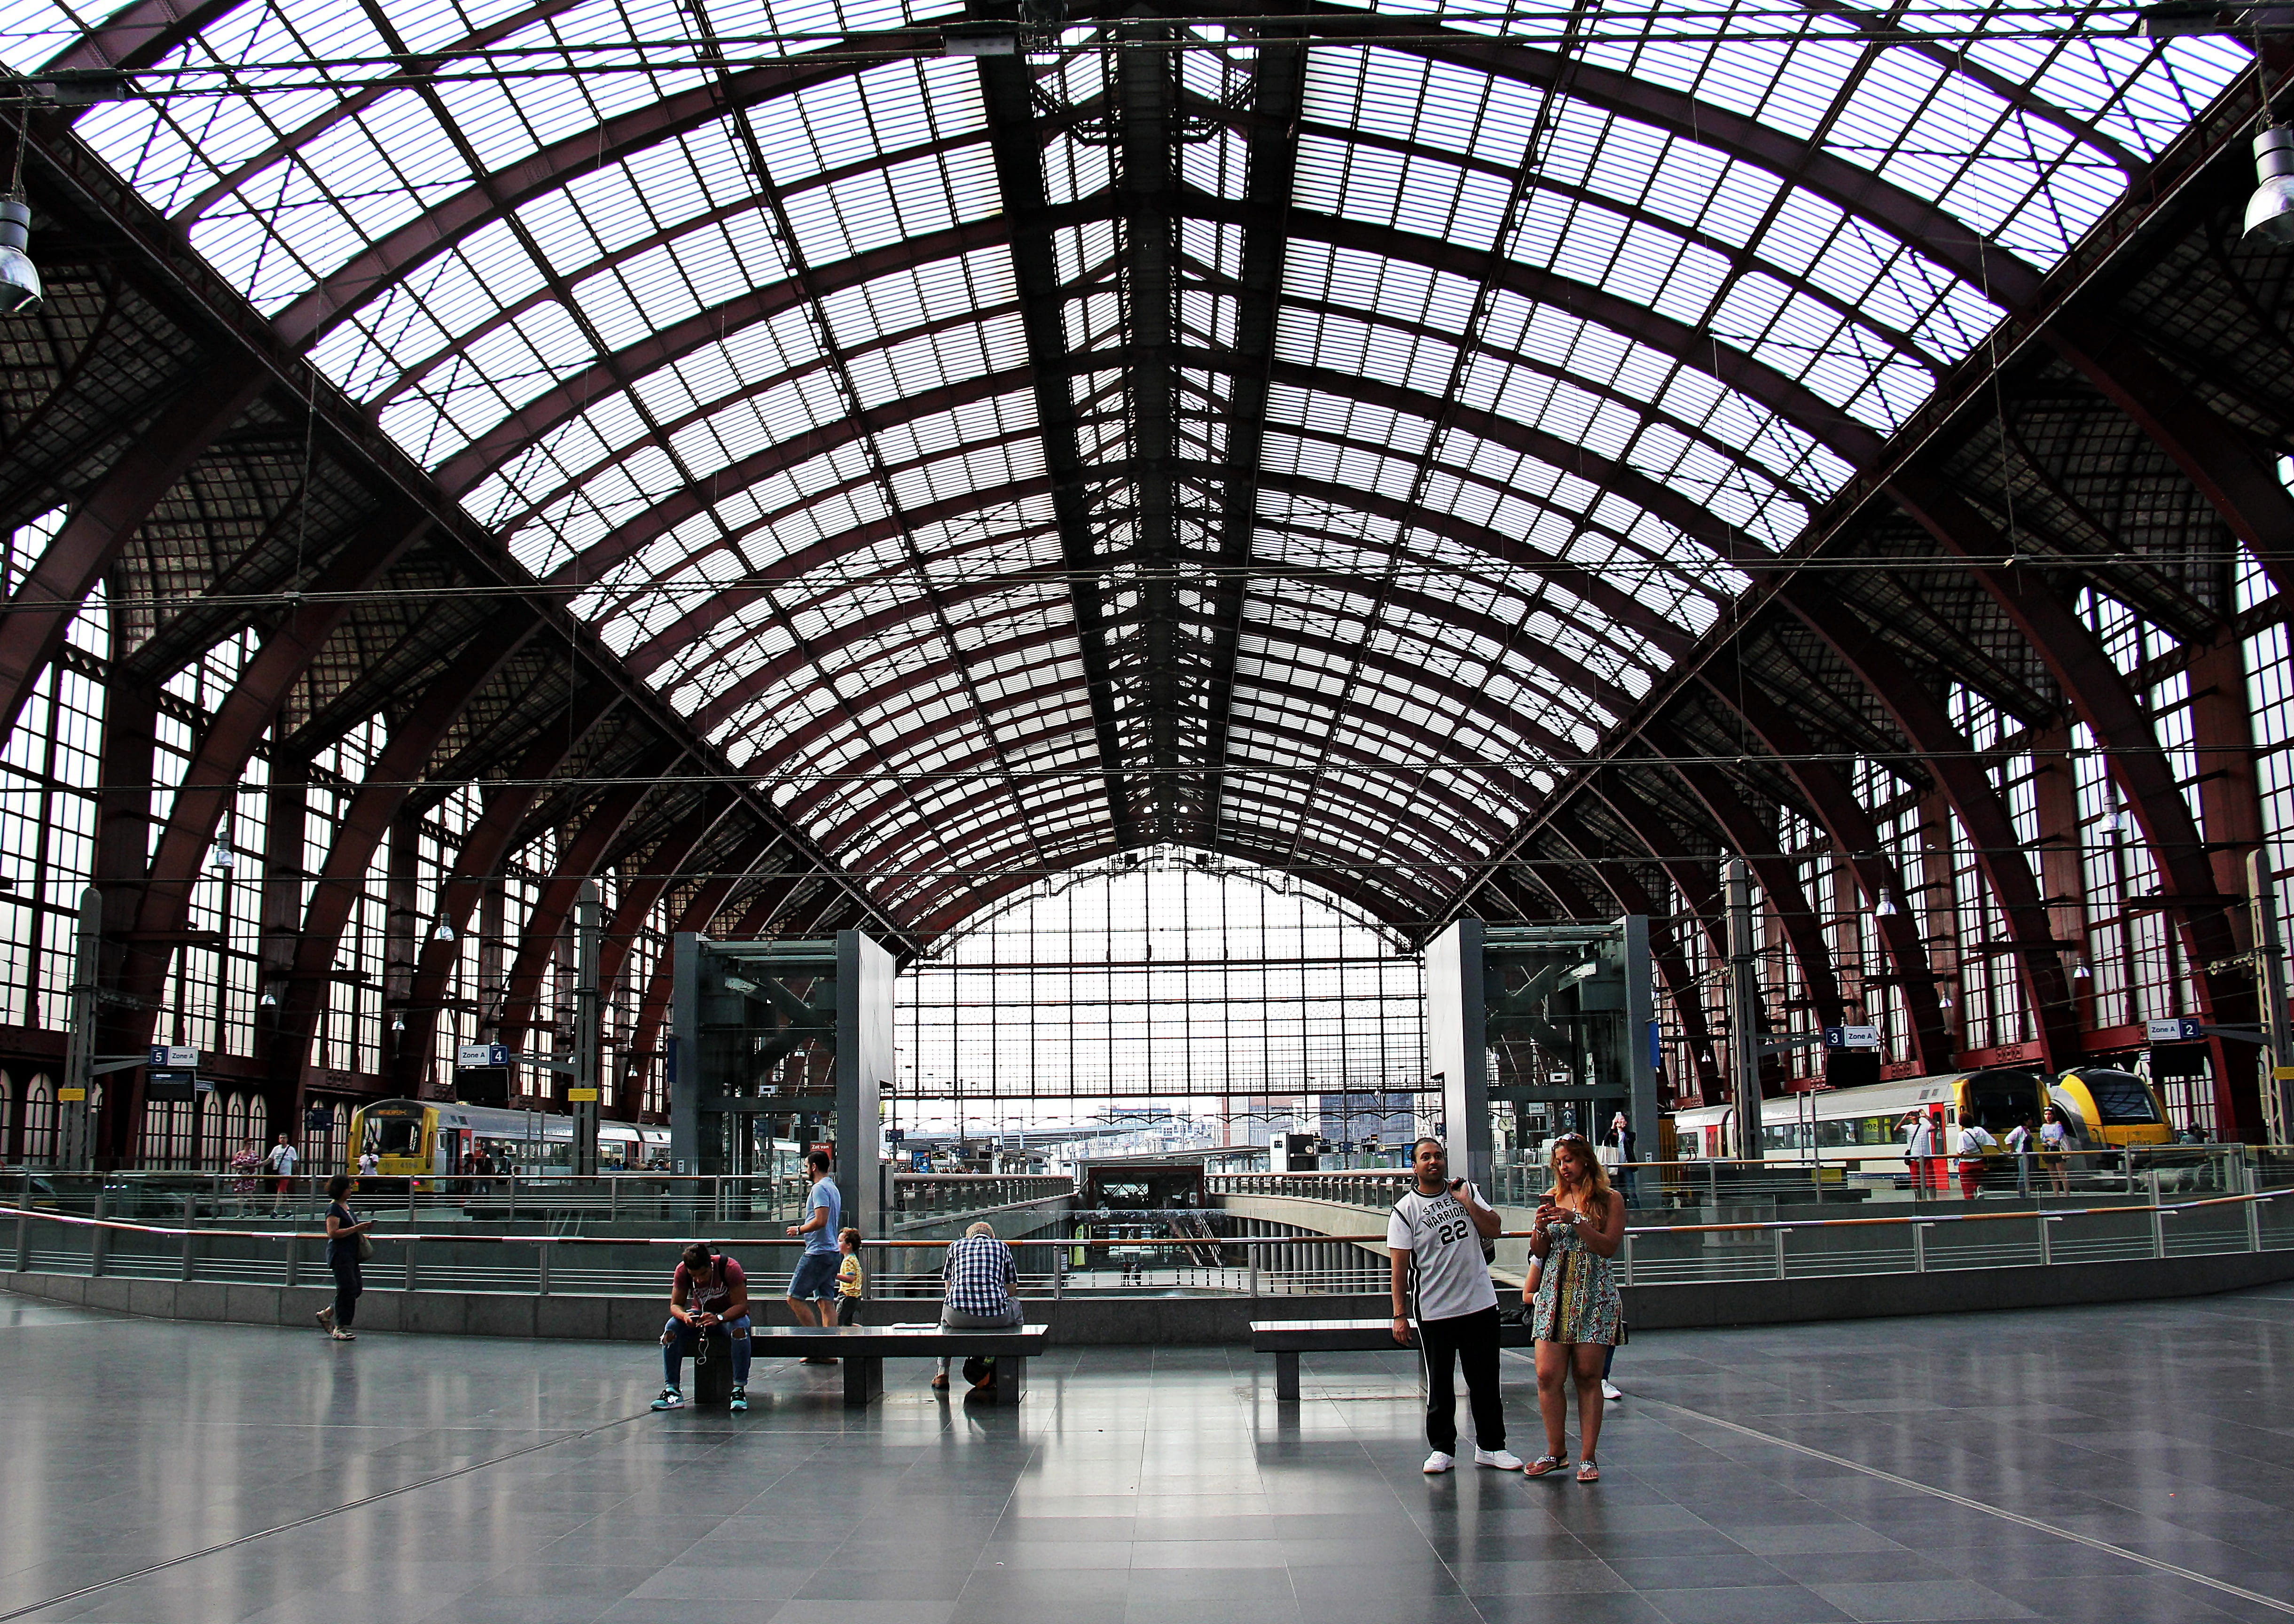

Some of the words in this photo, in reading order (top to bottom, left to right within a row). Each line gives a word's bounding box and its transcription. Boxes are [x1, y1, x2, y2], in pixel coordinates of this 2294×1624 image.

[2186, 1025, 2193, 1034] 2
[1831, 1033, 1838, 1043] 3
[155, 1053, 162, 1062] 5
[495, 1051, 502, 1061] 4
[1423, 1196, 1458, 1215] STREE
[1438, 1219, 1469, 1246] 22
